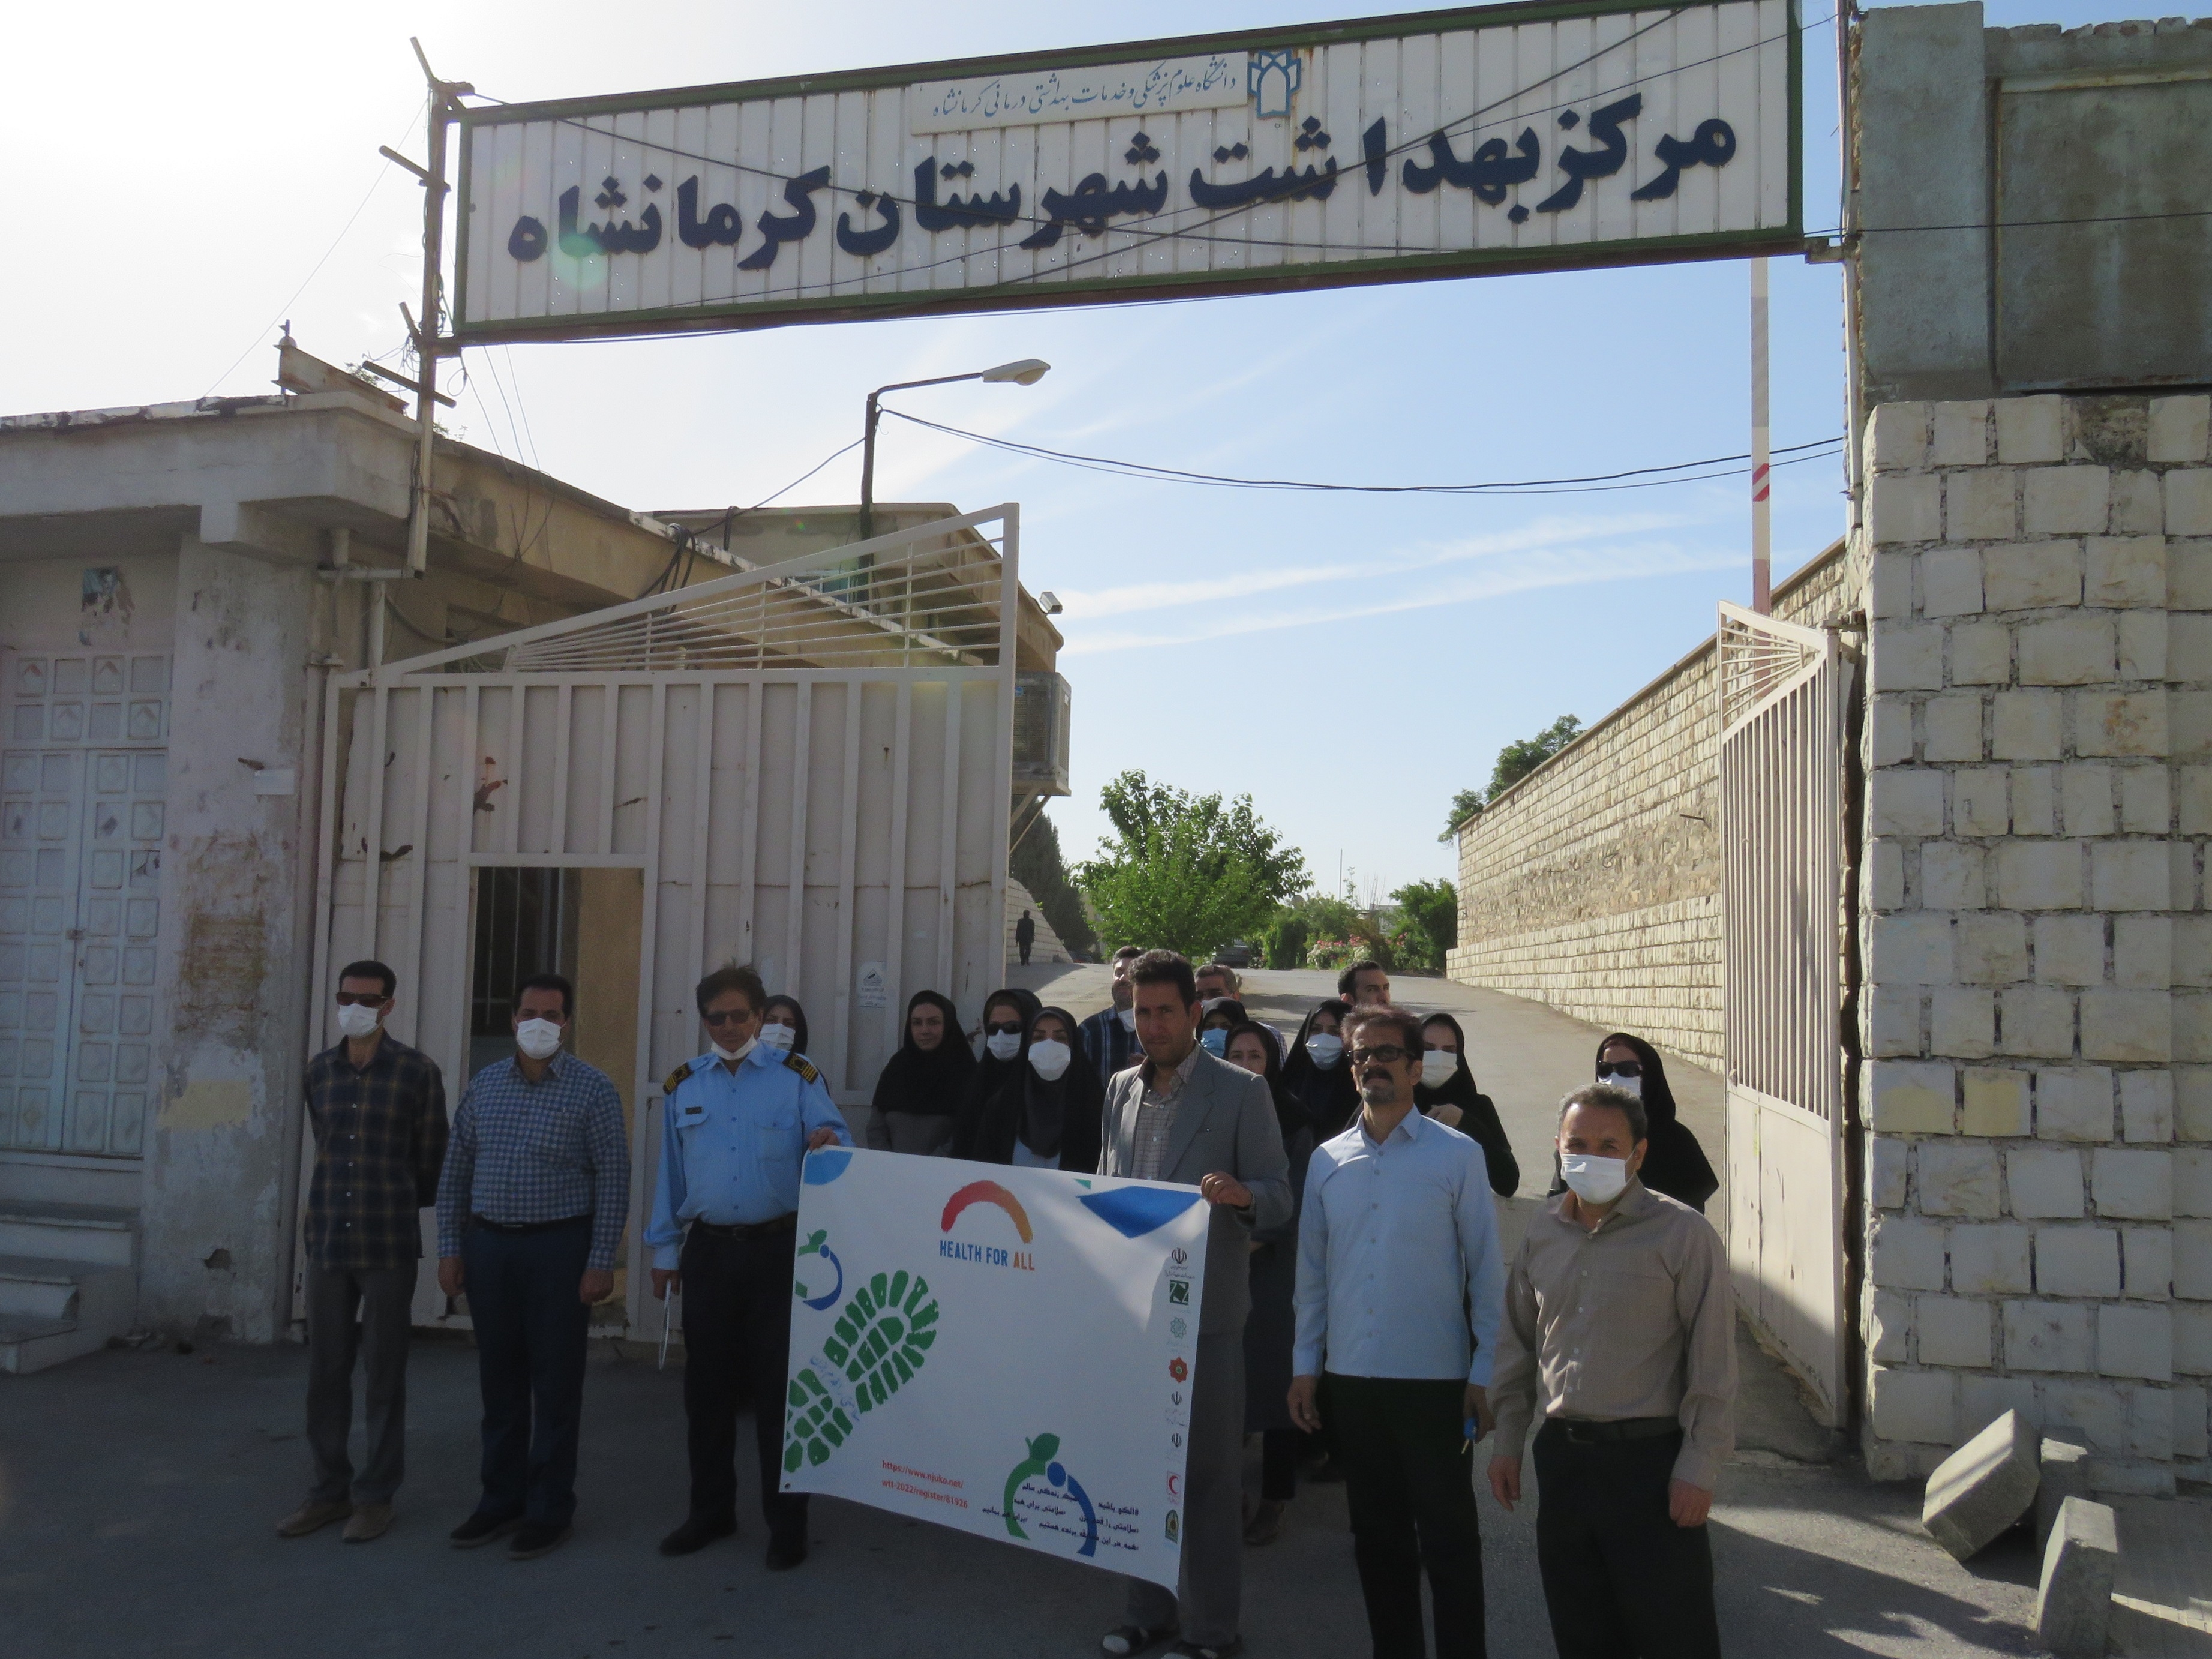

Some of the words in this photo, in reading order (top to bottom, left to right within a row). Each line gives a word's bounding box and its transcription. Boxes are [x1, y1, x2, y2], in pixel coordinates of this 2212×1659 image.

[1134, 60, 1169, 109] پزشکی
[1169, 67, 1196, 101] علوم
[1196, 55, 1236, 93] دانشگاه
[932, 80, 1000, 117] کرمانشاه
[985, 84, 1026, 118] درمانی
[1028, 73, 1070, 115] بهداشتی
[1071, 83, 1127, 104] خدمات
[1189, 115, 1541, 224] بهداشت
[1536, 92, 1736, 214] مرکز
[836, 131, 1169, 257] شهرستان
[508, 164, 831, 271] کرمانشاه
[939, 1240, 982, 1262] HEALTH
[986, 1247, 1009, 1267] FOR
[1013, 1251, 1035, 1271] ALL
[882, 1460, 964, 1489] https://www.njuko.net/
